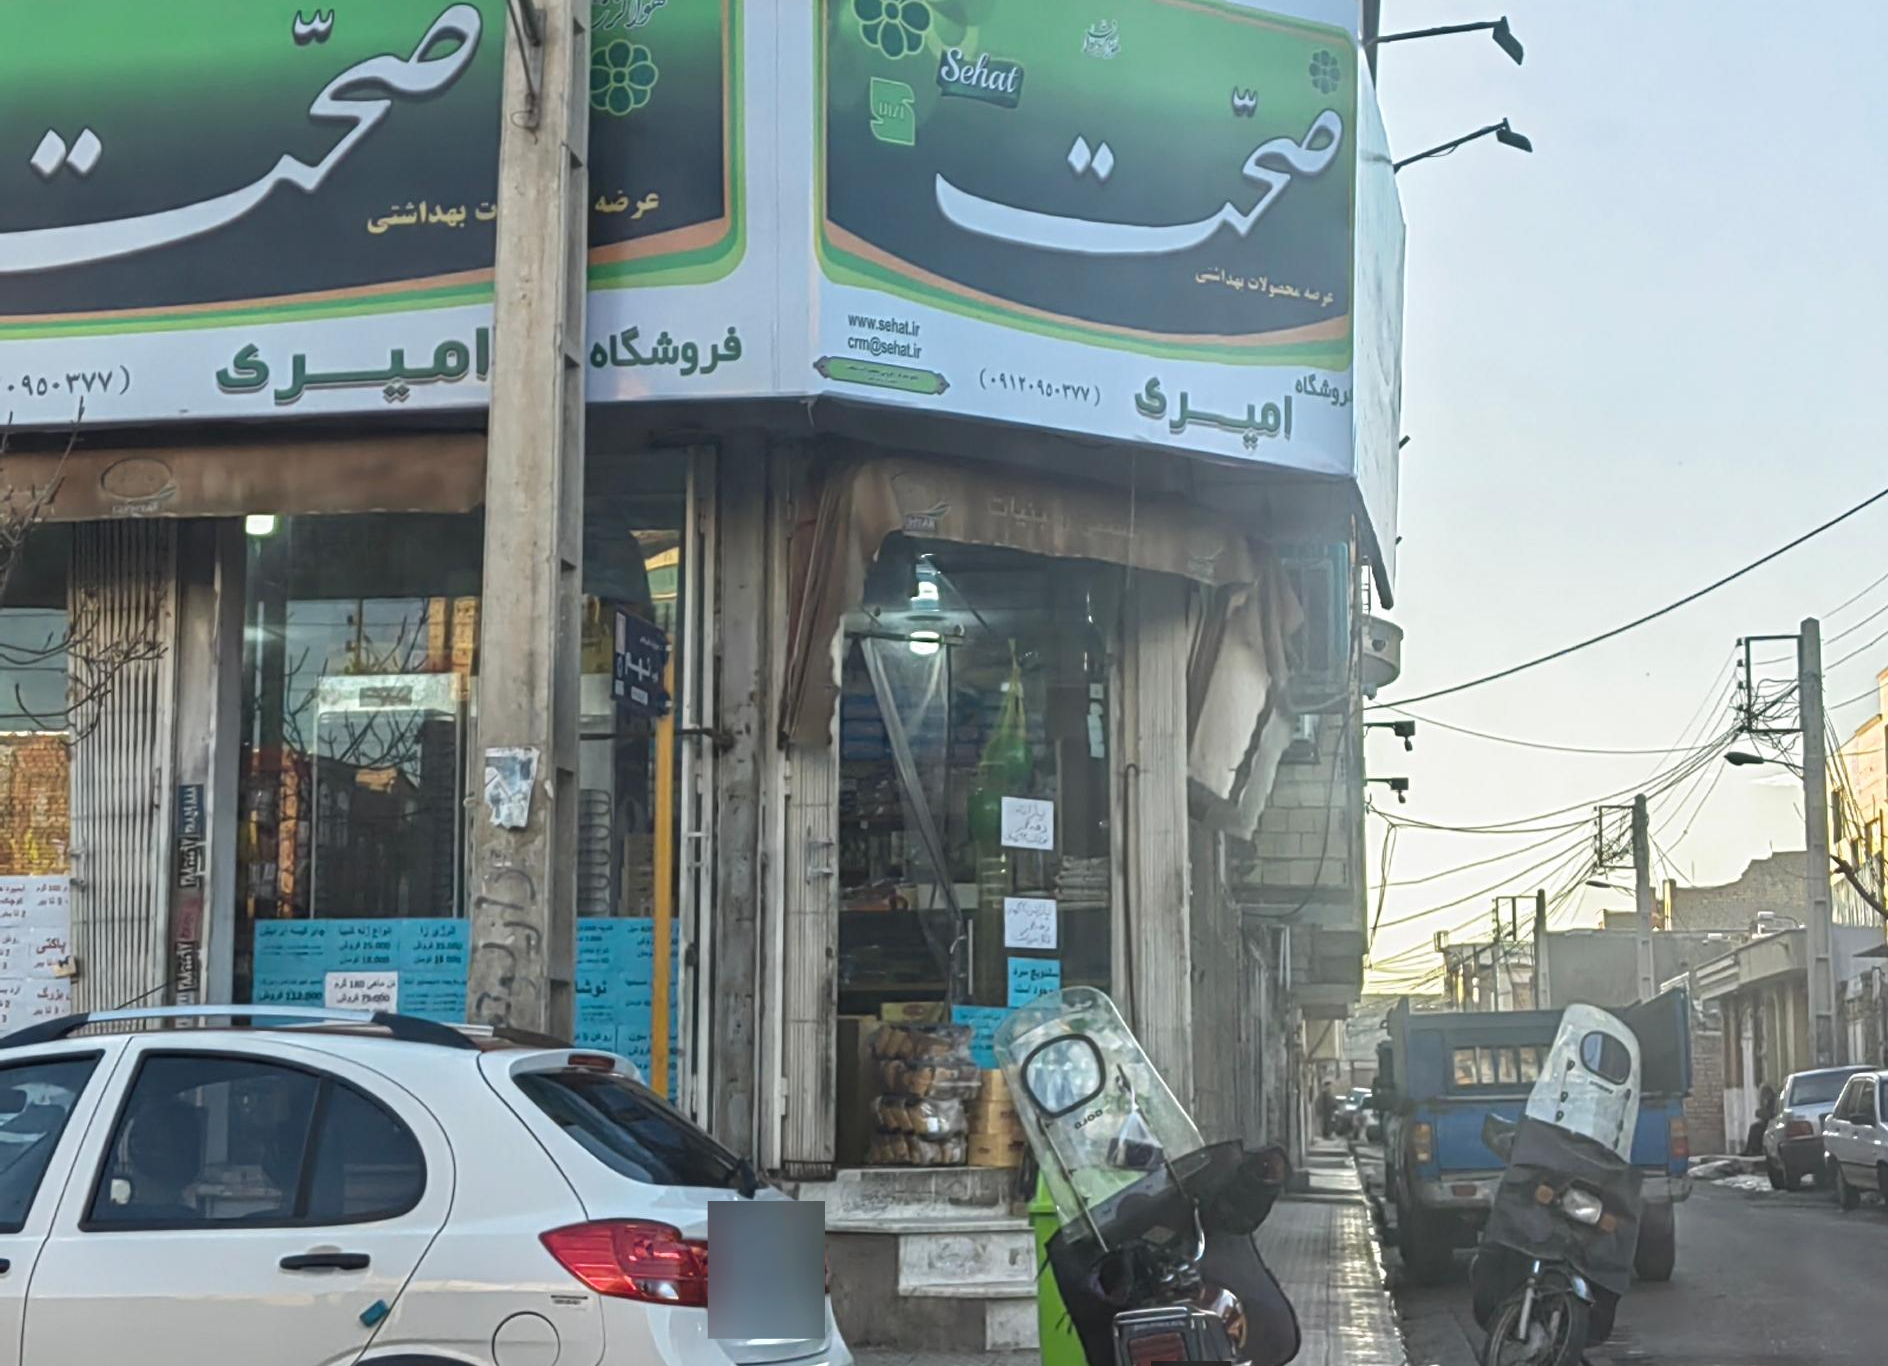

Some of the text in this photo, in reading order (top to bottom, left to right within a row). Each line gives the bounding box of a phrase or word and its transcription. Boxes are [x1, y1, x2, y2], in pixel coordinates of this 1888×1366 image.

[941, 47, 1020, 93] Sehat
[367, 199, 467, 234] بهداشتی
[594, 189, 659, 220] عرضه
[847, 312, 921, 337] www.sehat.ir
[847, 334, 922, 359] crm@sehat.ir
[215, 325, 743, 404] فروشگاه امیری
[1134, 376, 1293, 448] امیری
